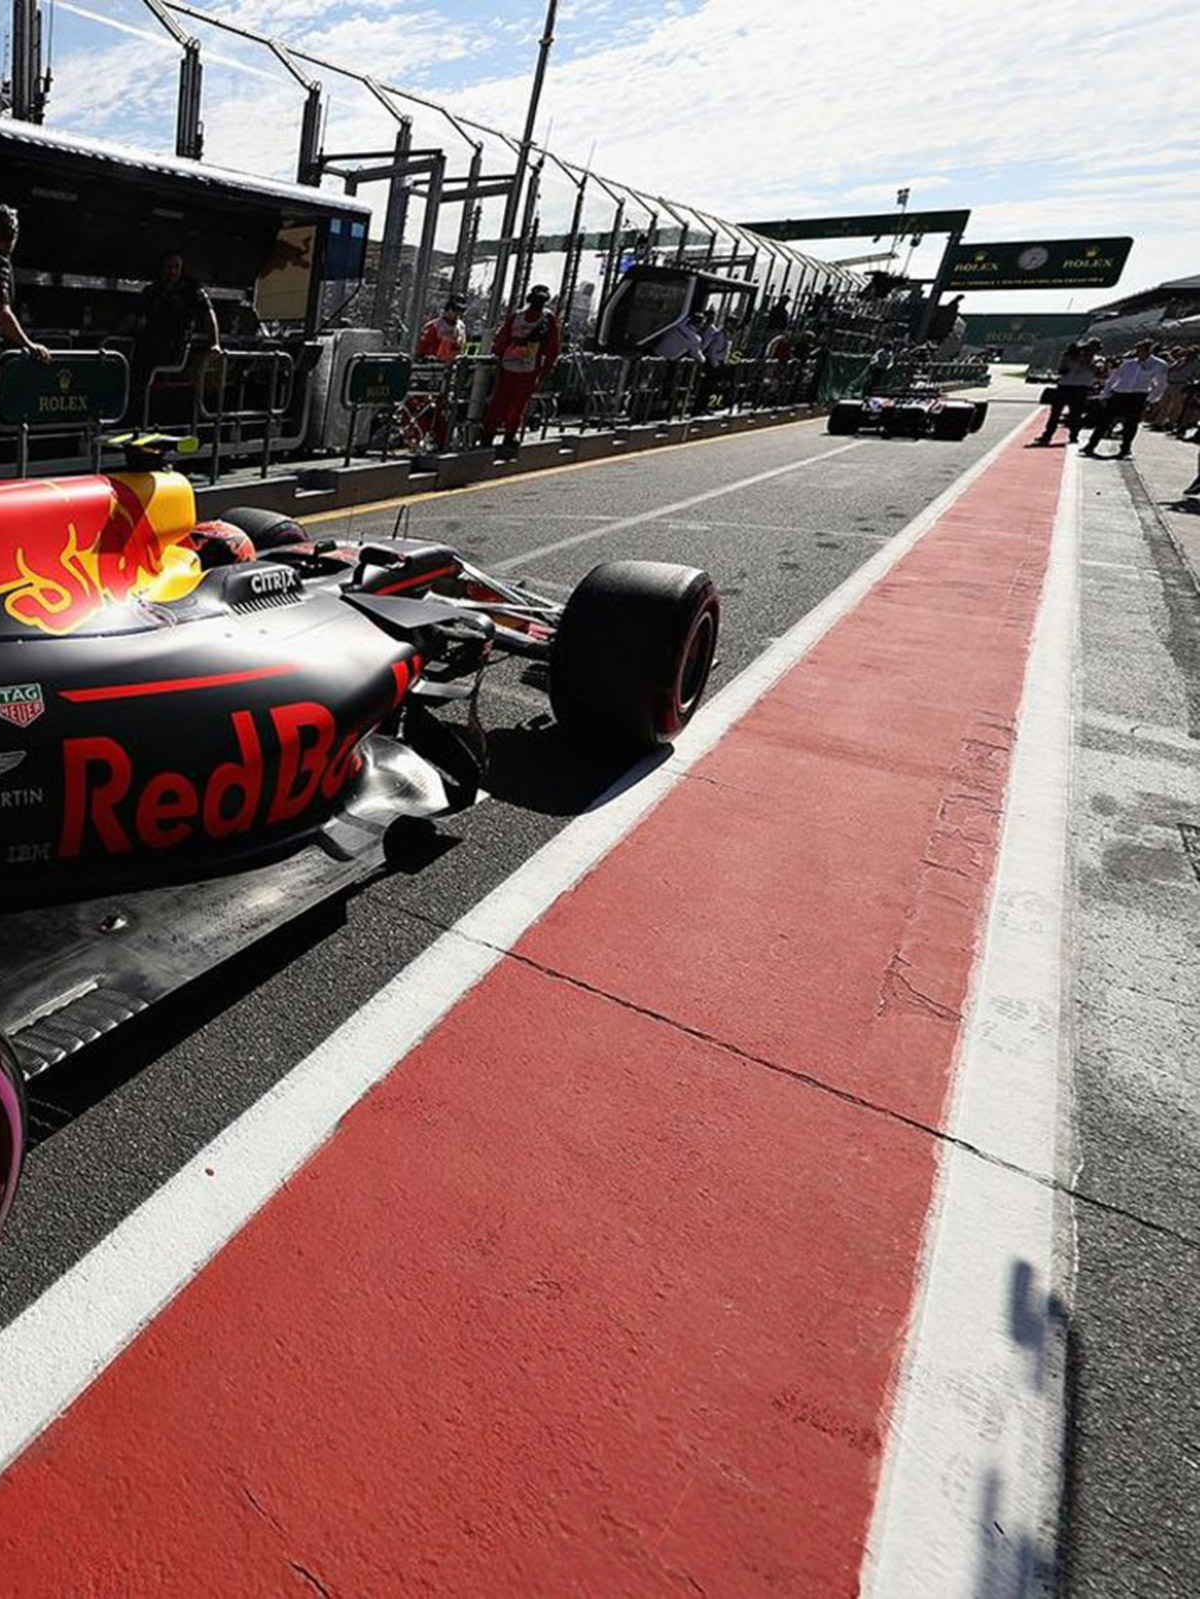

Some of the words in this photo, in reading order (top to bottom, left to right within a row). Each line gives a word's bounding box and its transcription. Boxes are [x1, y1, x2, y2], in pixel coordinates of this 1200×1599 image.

[954, 261, 999, 272] ROLEX
[1062, 257, 1115, 270] ROLEX
[39, 395, 88, 412] ROLEX
[251, 569, 297, 595] CITRIX
[0, 686, 38, 702] TAG
[0, 702, 41, 723] HEUER
[55, 709, 266, 860] Red
[6, 842, 52, 864] IBM
